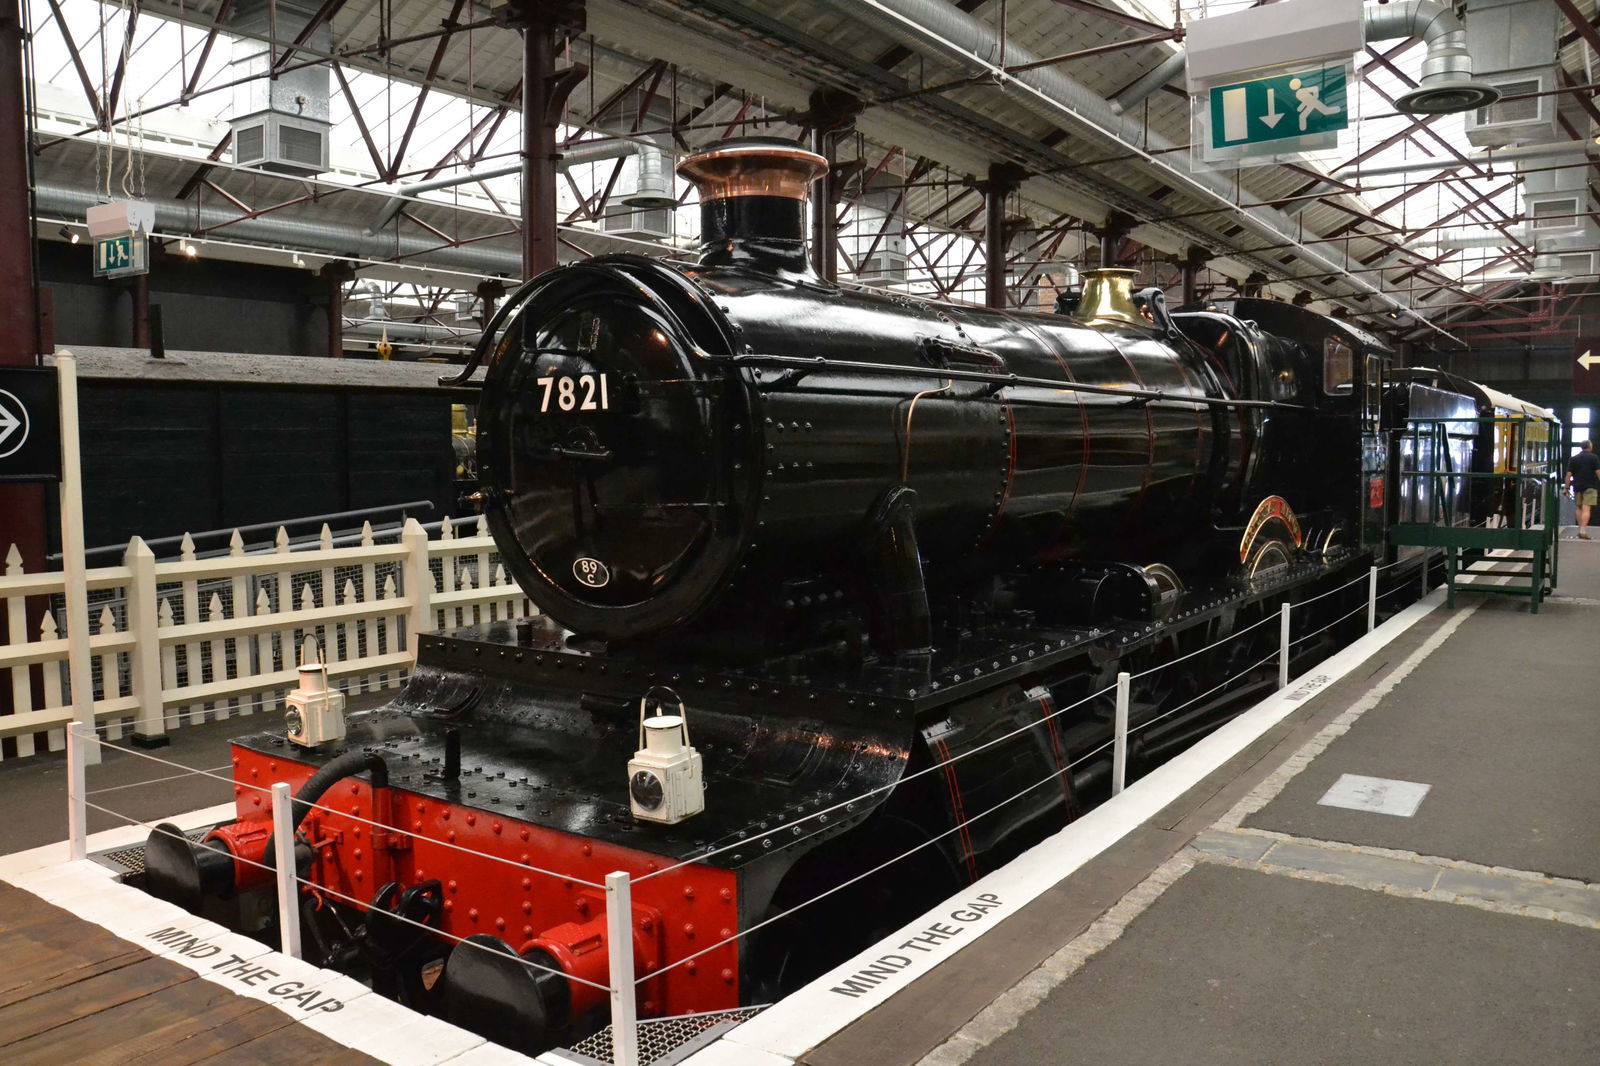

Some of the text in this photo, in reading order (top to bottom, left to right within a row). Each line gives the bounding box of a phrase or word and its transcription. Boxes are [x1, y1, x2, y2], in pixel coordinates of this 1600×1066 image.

[537, 373, 609, 413] 7821
[581, 560, 597, 574] 89
[587, 574, 595, 584] C
[828, 893, 1003, 998] MIND THE GAP
[145, 927, 345, 1013] MIND THE GAP
